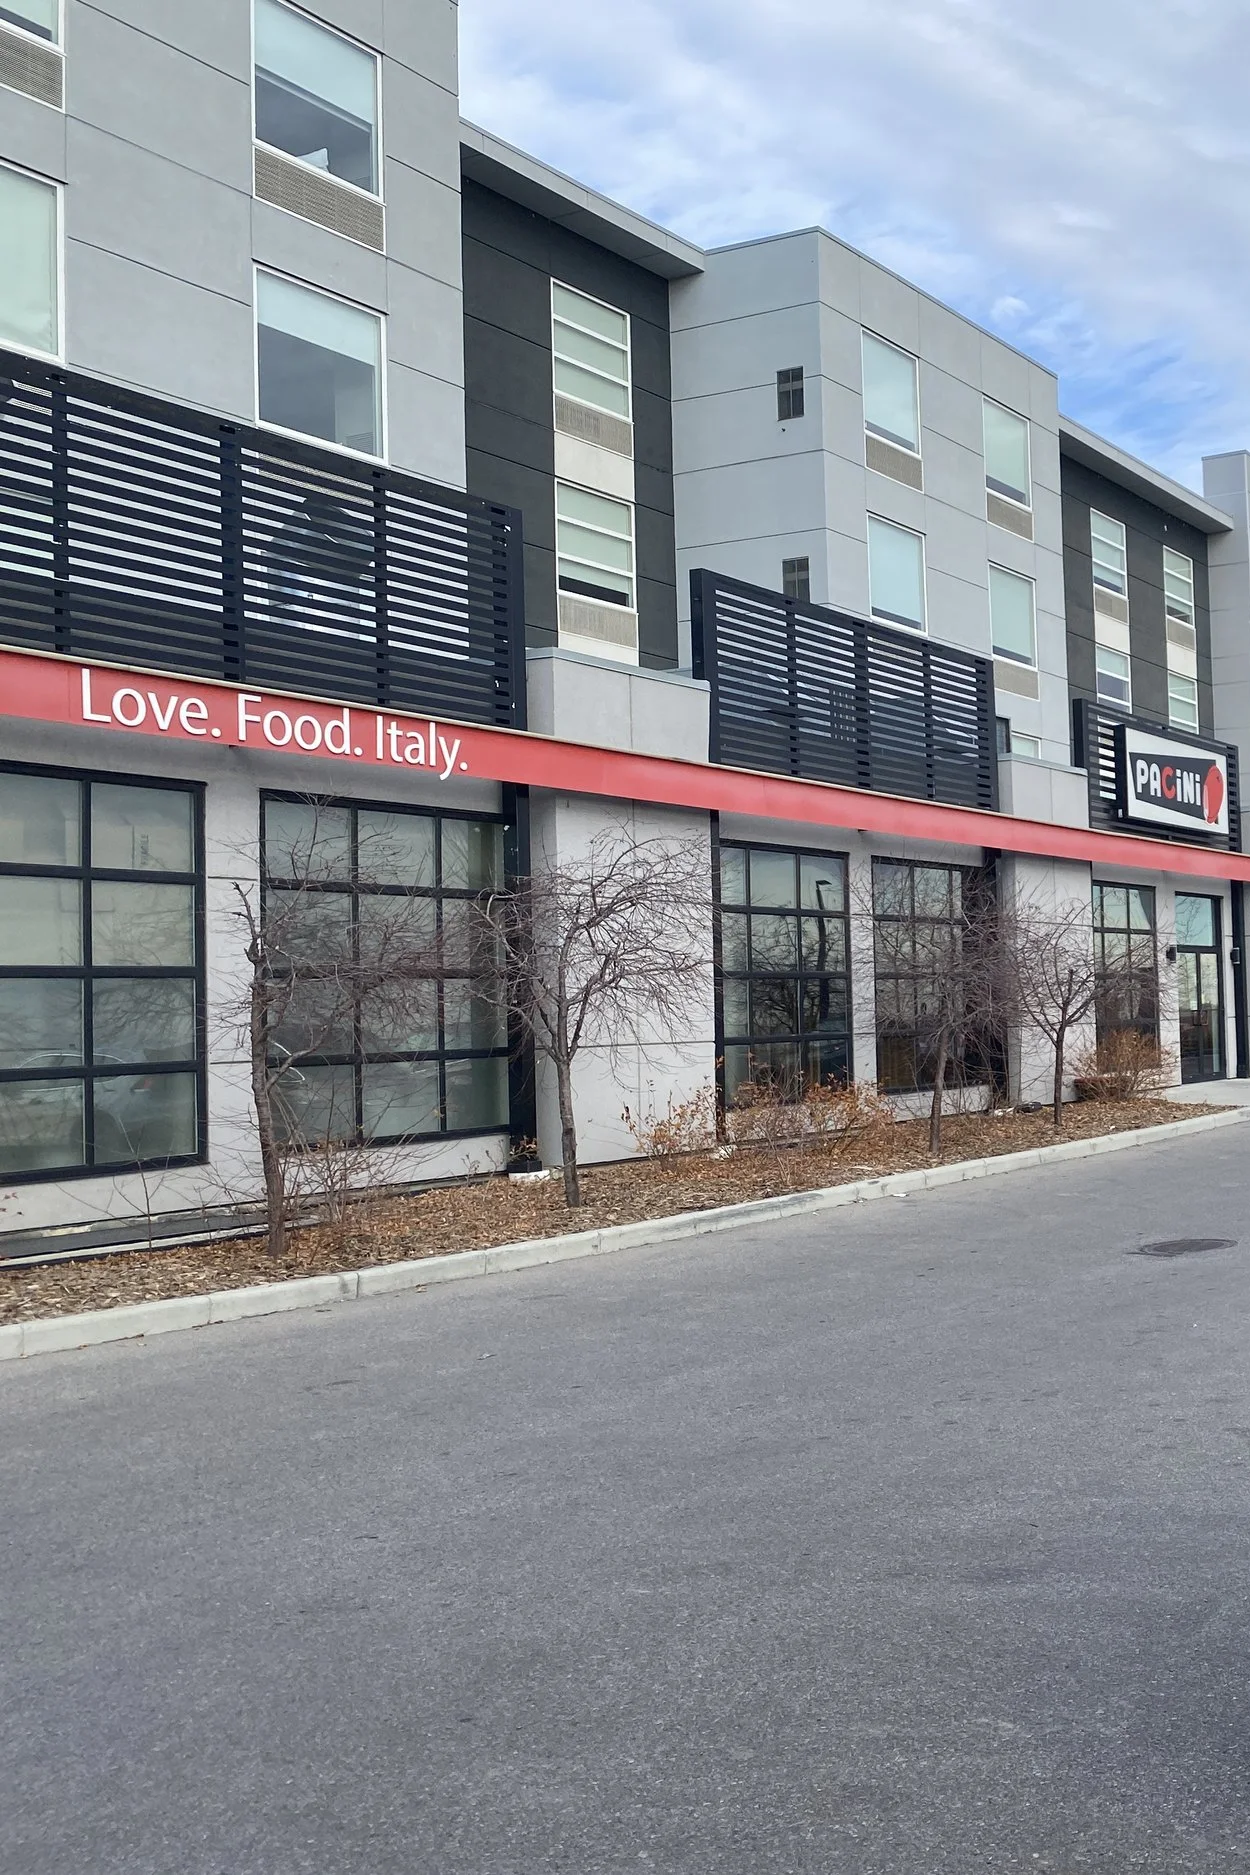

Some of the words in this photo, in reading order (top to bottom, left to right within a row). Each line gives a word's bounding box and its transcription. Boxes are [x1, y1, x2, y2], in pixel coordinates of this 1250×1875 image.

[82, 668, 221, 738] Love.
[237, 693, 363, 756] Food.
[376, 715, 468, 781] Italy.
